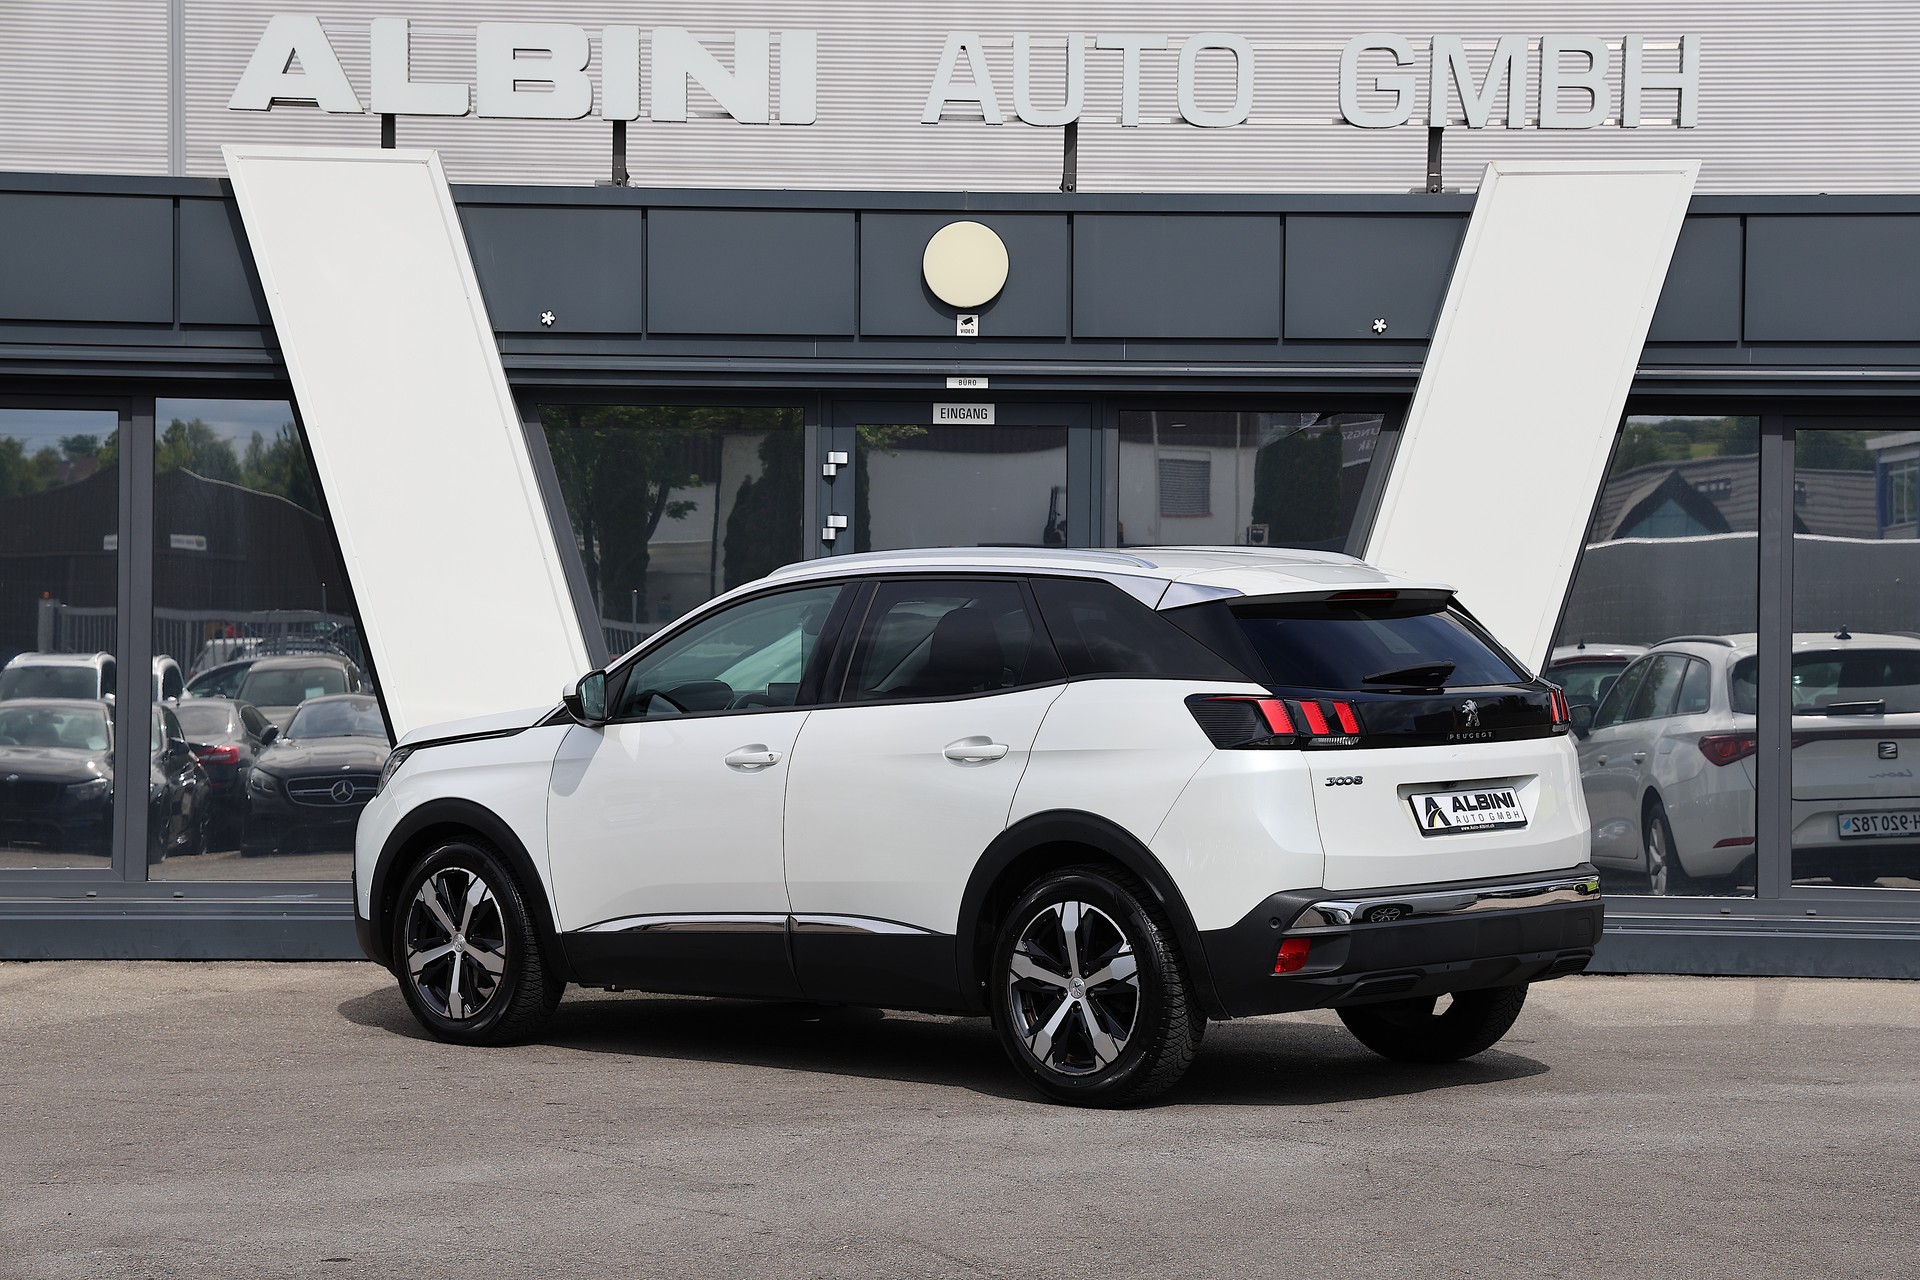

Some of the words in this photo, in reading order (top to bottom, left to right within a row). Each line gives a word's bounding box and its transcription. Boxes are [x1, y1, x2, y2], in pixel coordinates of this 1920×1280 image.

[227, 15, 818, 125] ALBINI
[920, 31, 1255, 128] AUTO
[1339, 32, 1701, 130] GMBH
[958, 377, 977, 386] BÜRO
[940, 407, 988, 420] EINGANG
[1449, 731, 1493, 740] PEUGEOT
[1325, 775, 1364, 787] 3008
[1452, 791, 1516, 813] ALBINI
[1455, 813, 1485, 824] AUTO
[1488, 811, 1521, 821] GMBH
